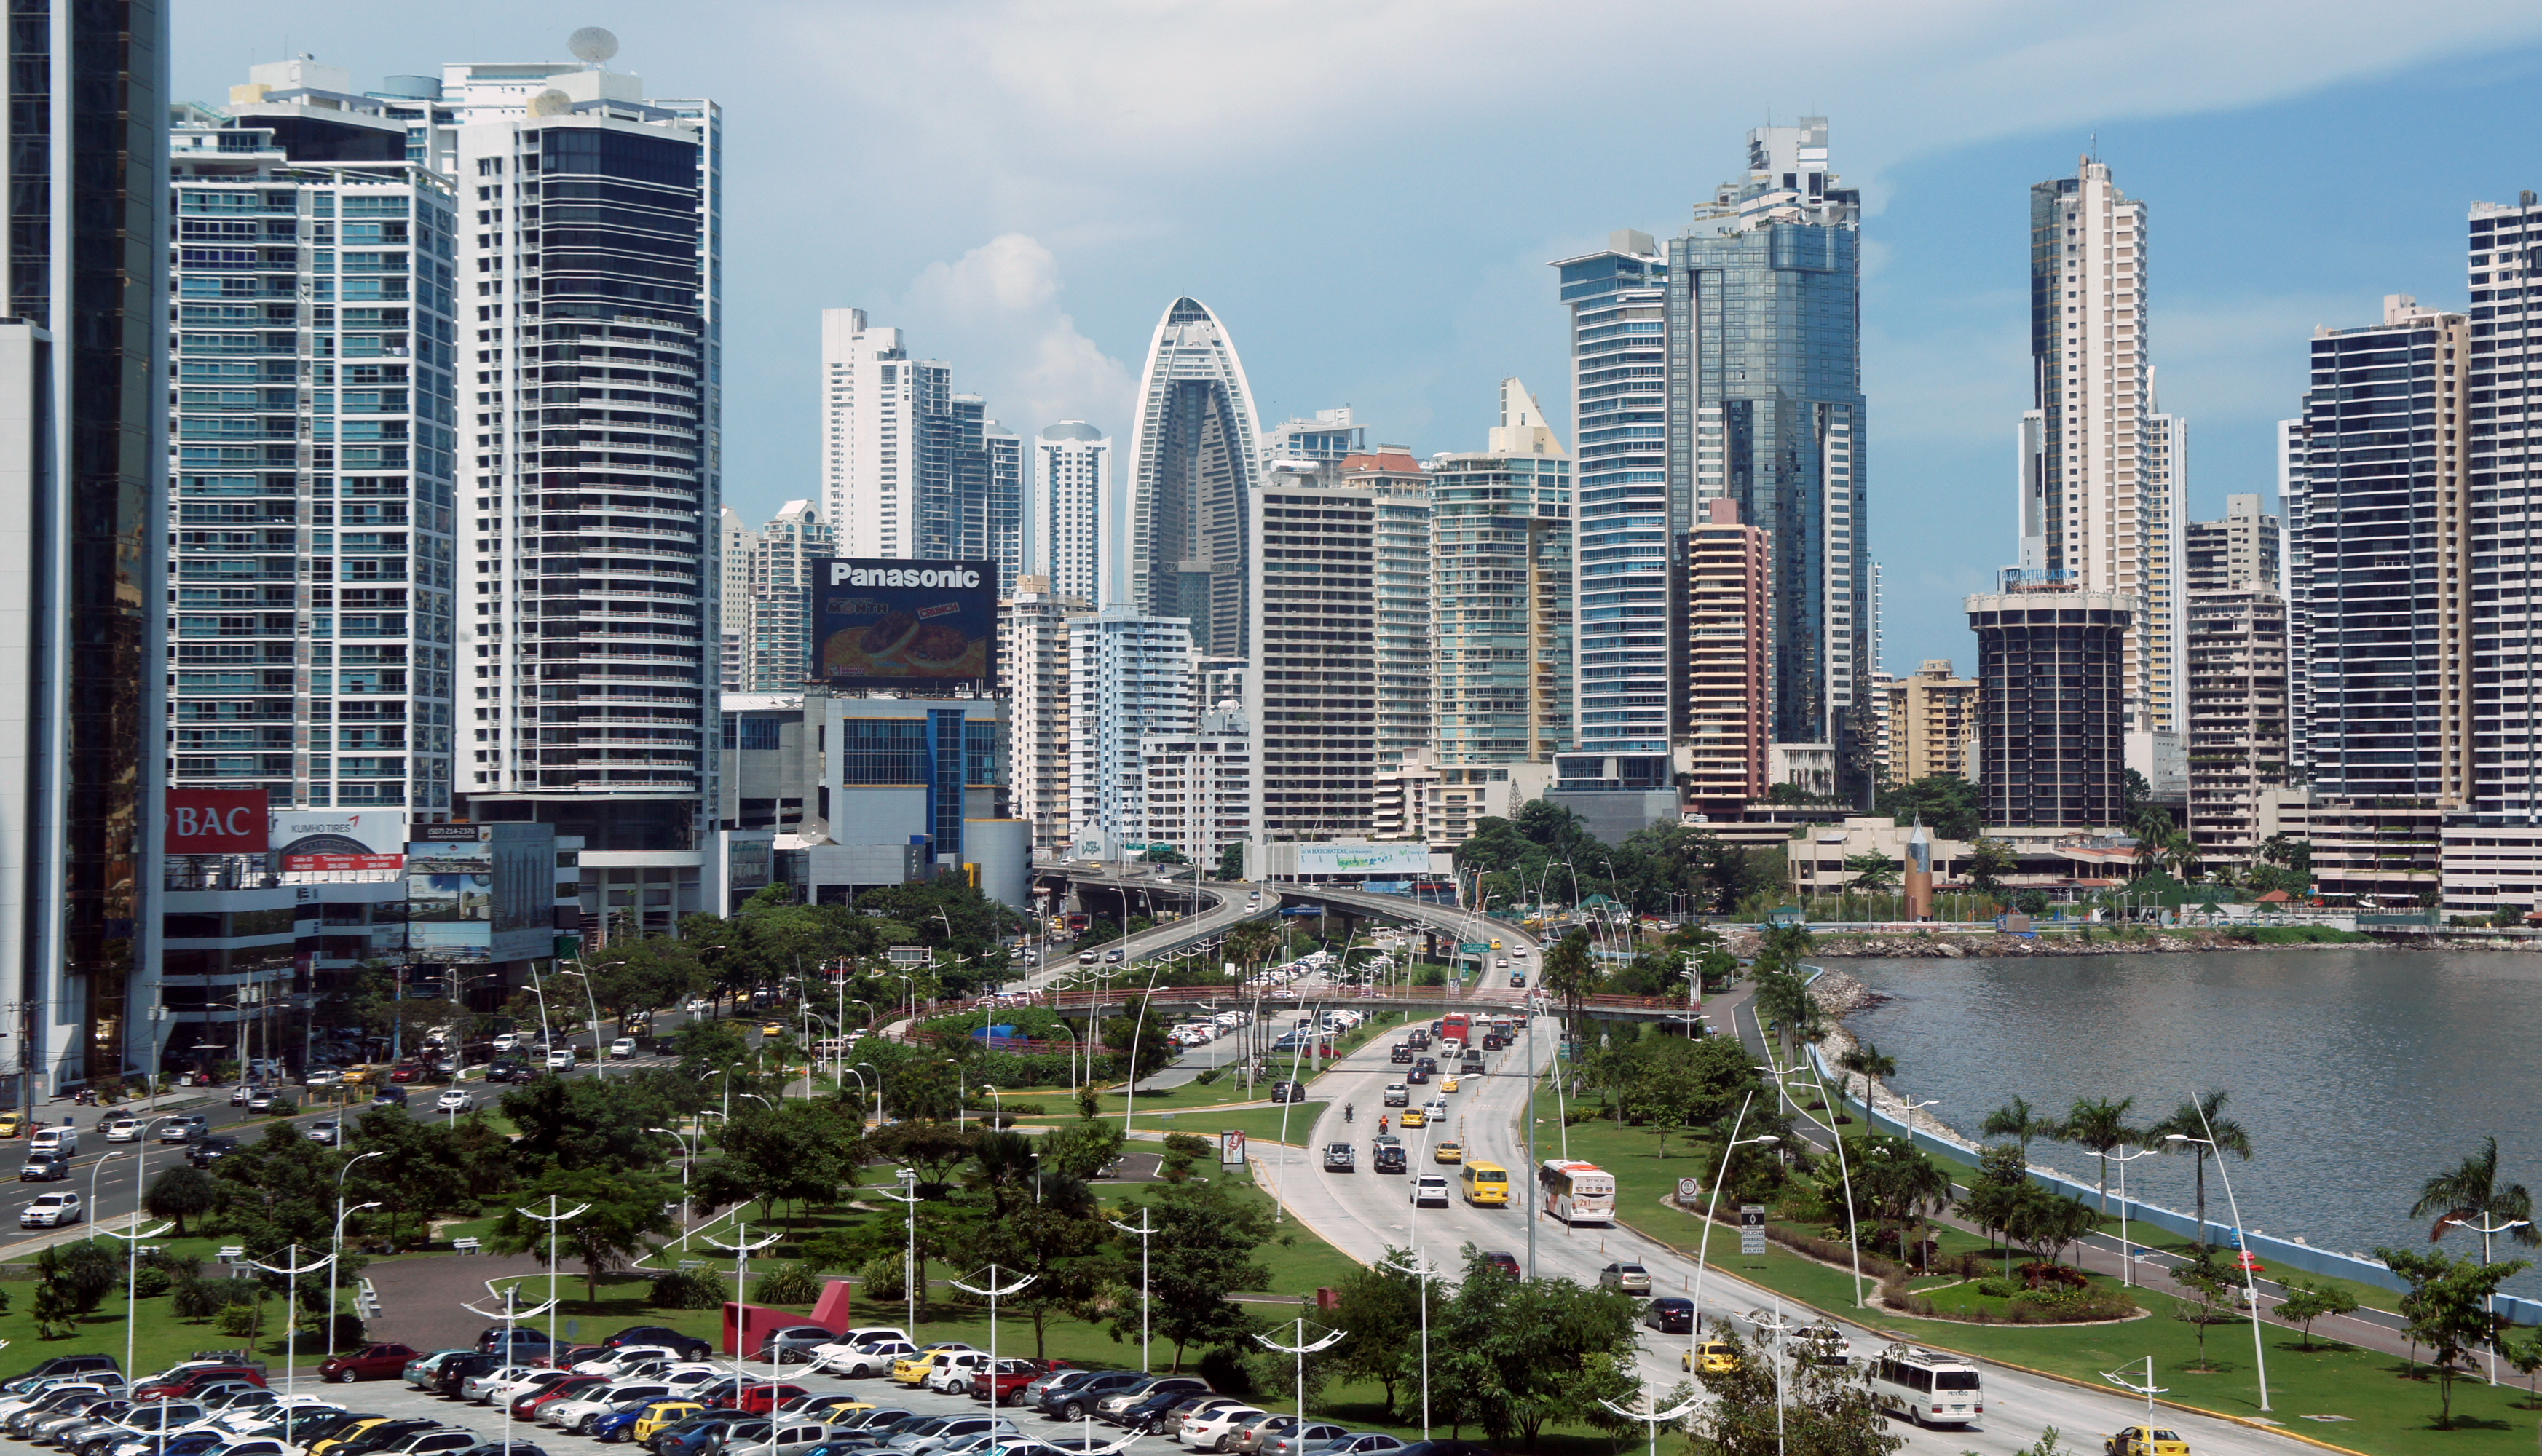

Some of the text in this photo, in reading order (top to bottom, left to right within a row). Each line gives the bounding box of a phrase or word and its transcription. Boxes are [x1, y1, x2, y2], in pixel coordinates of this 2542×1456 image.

[831, 562, 980, 588] Panasonic
[2058, 569, 2075, 579] INN
[826, 602, 888, 614] MONTH
[919, 603, 959, 618] CRUNCH
[175, 807, 250, 836] BAC
[292, 824, 350, 833] KUMHO TIRES
[1579, 1198, 1590, 1206] 2x1
